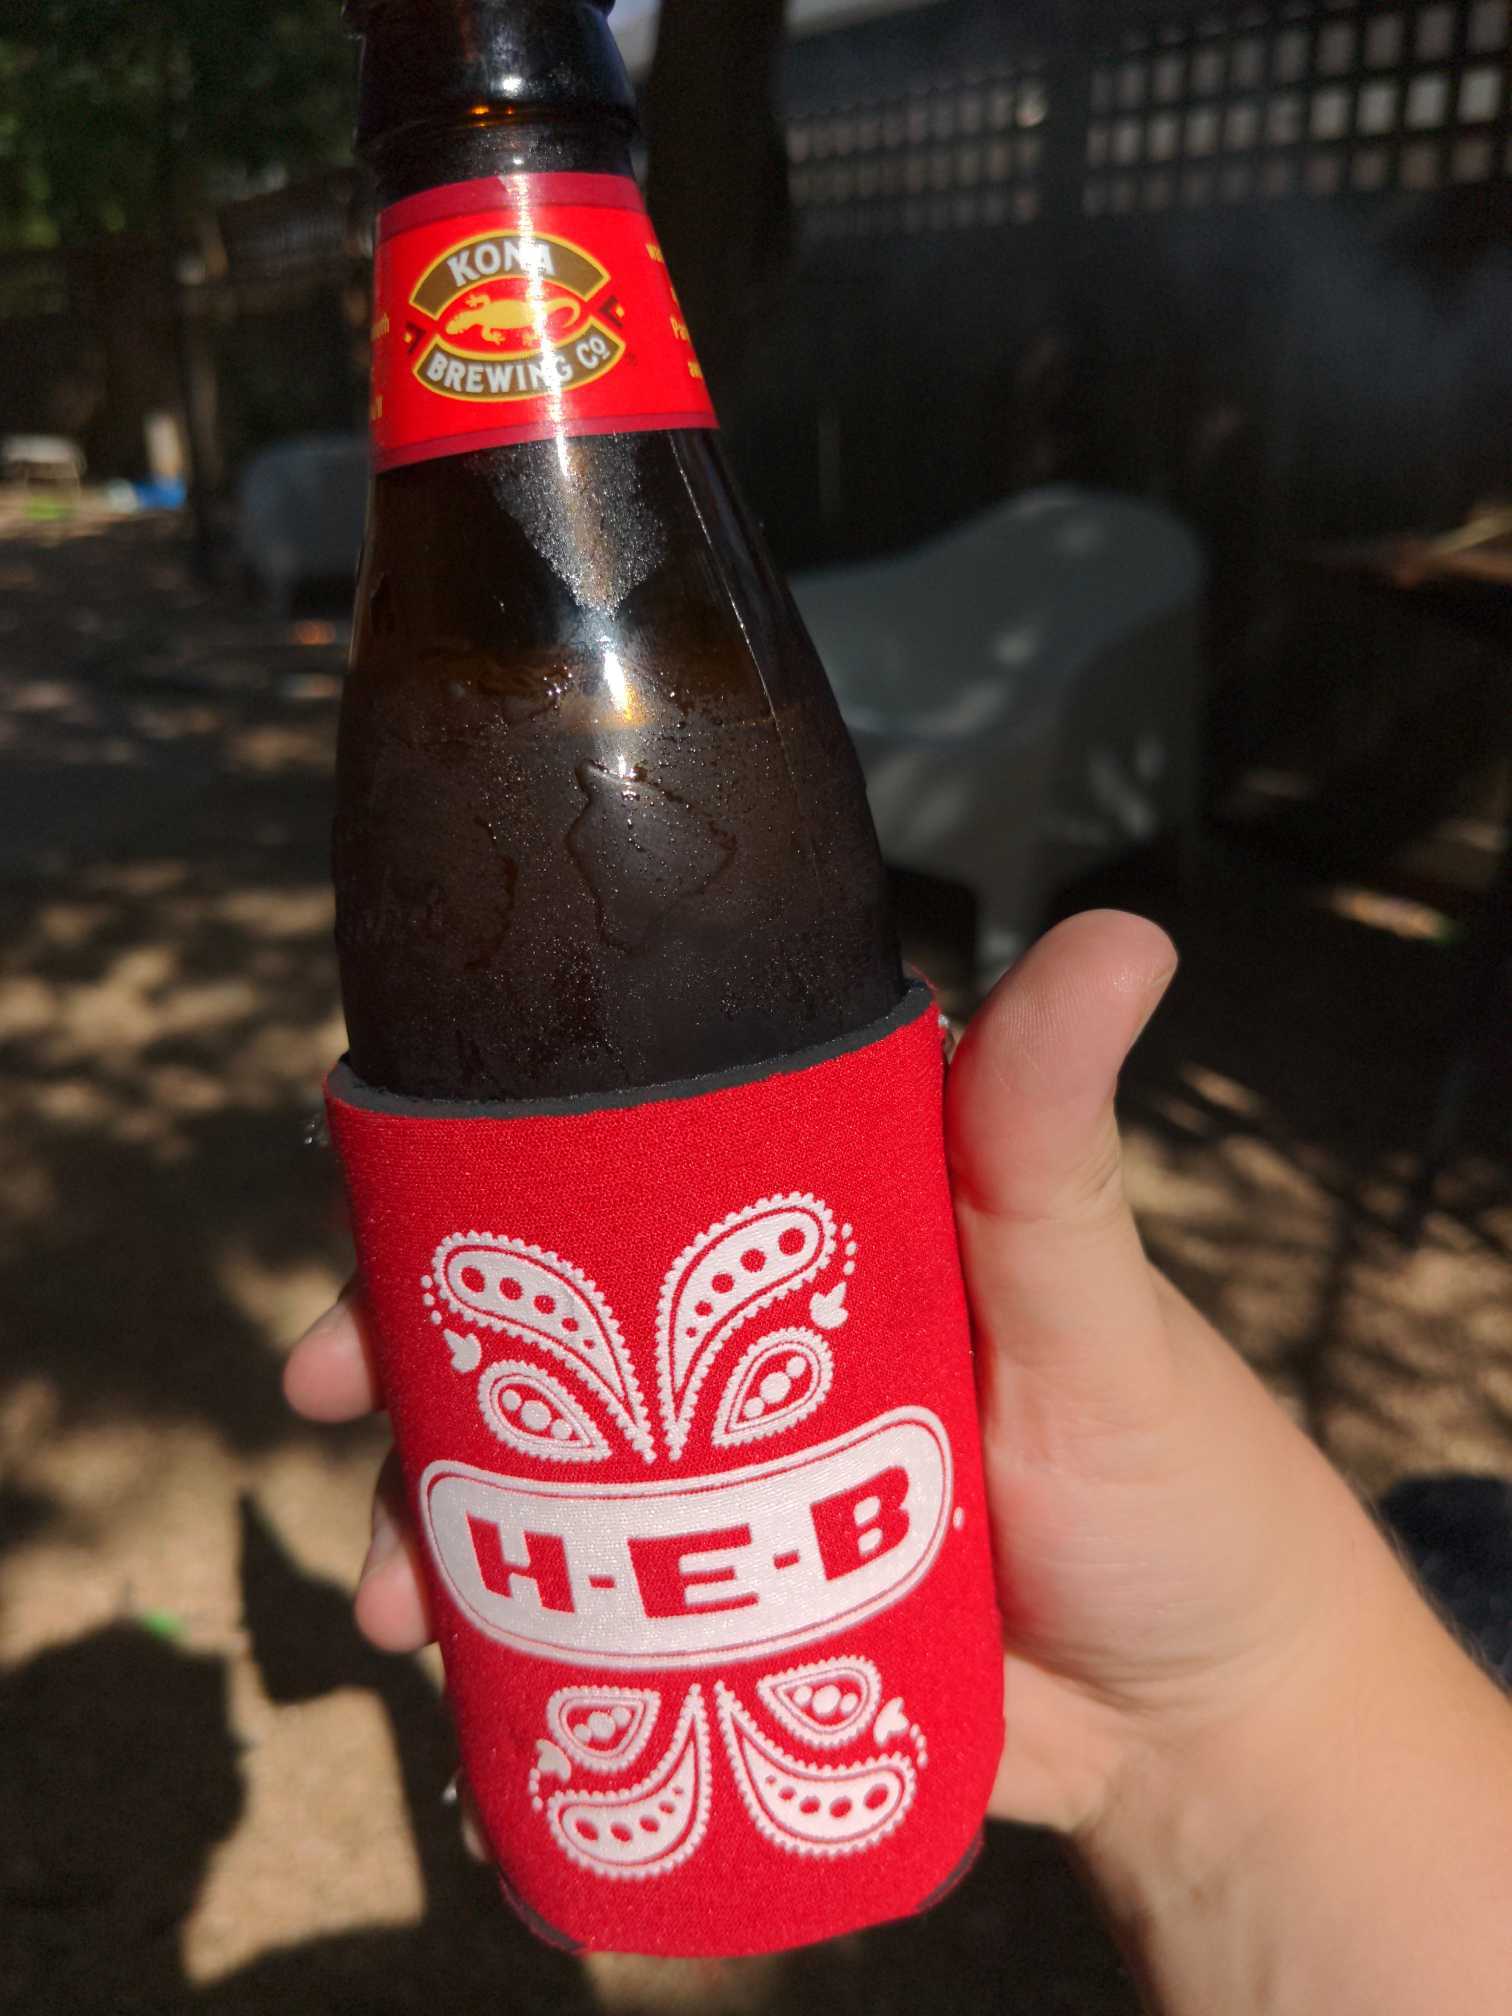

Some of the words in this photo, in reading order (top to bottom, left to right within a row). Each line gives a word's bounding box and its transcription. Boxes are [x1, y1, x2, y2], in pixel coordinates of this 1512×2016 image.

[447, 241, 555, 287] KONA
[425, 350, 574, 394] BREWING
[466, 1465, 910, 1619] H-E-B
